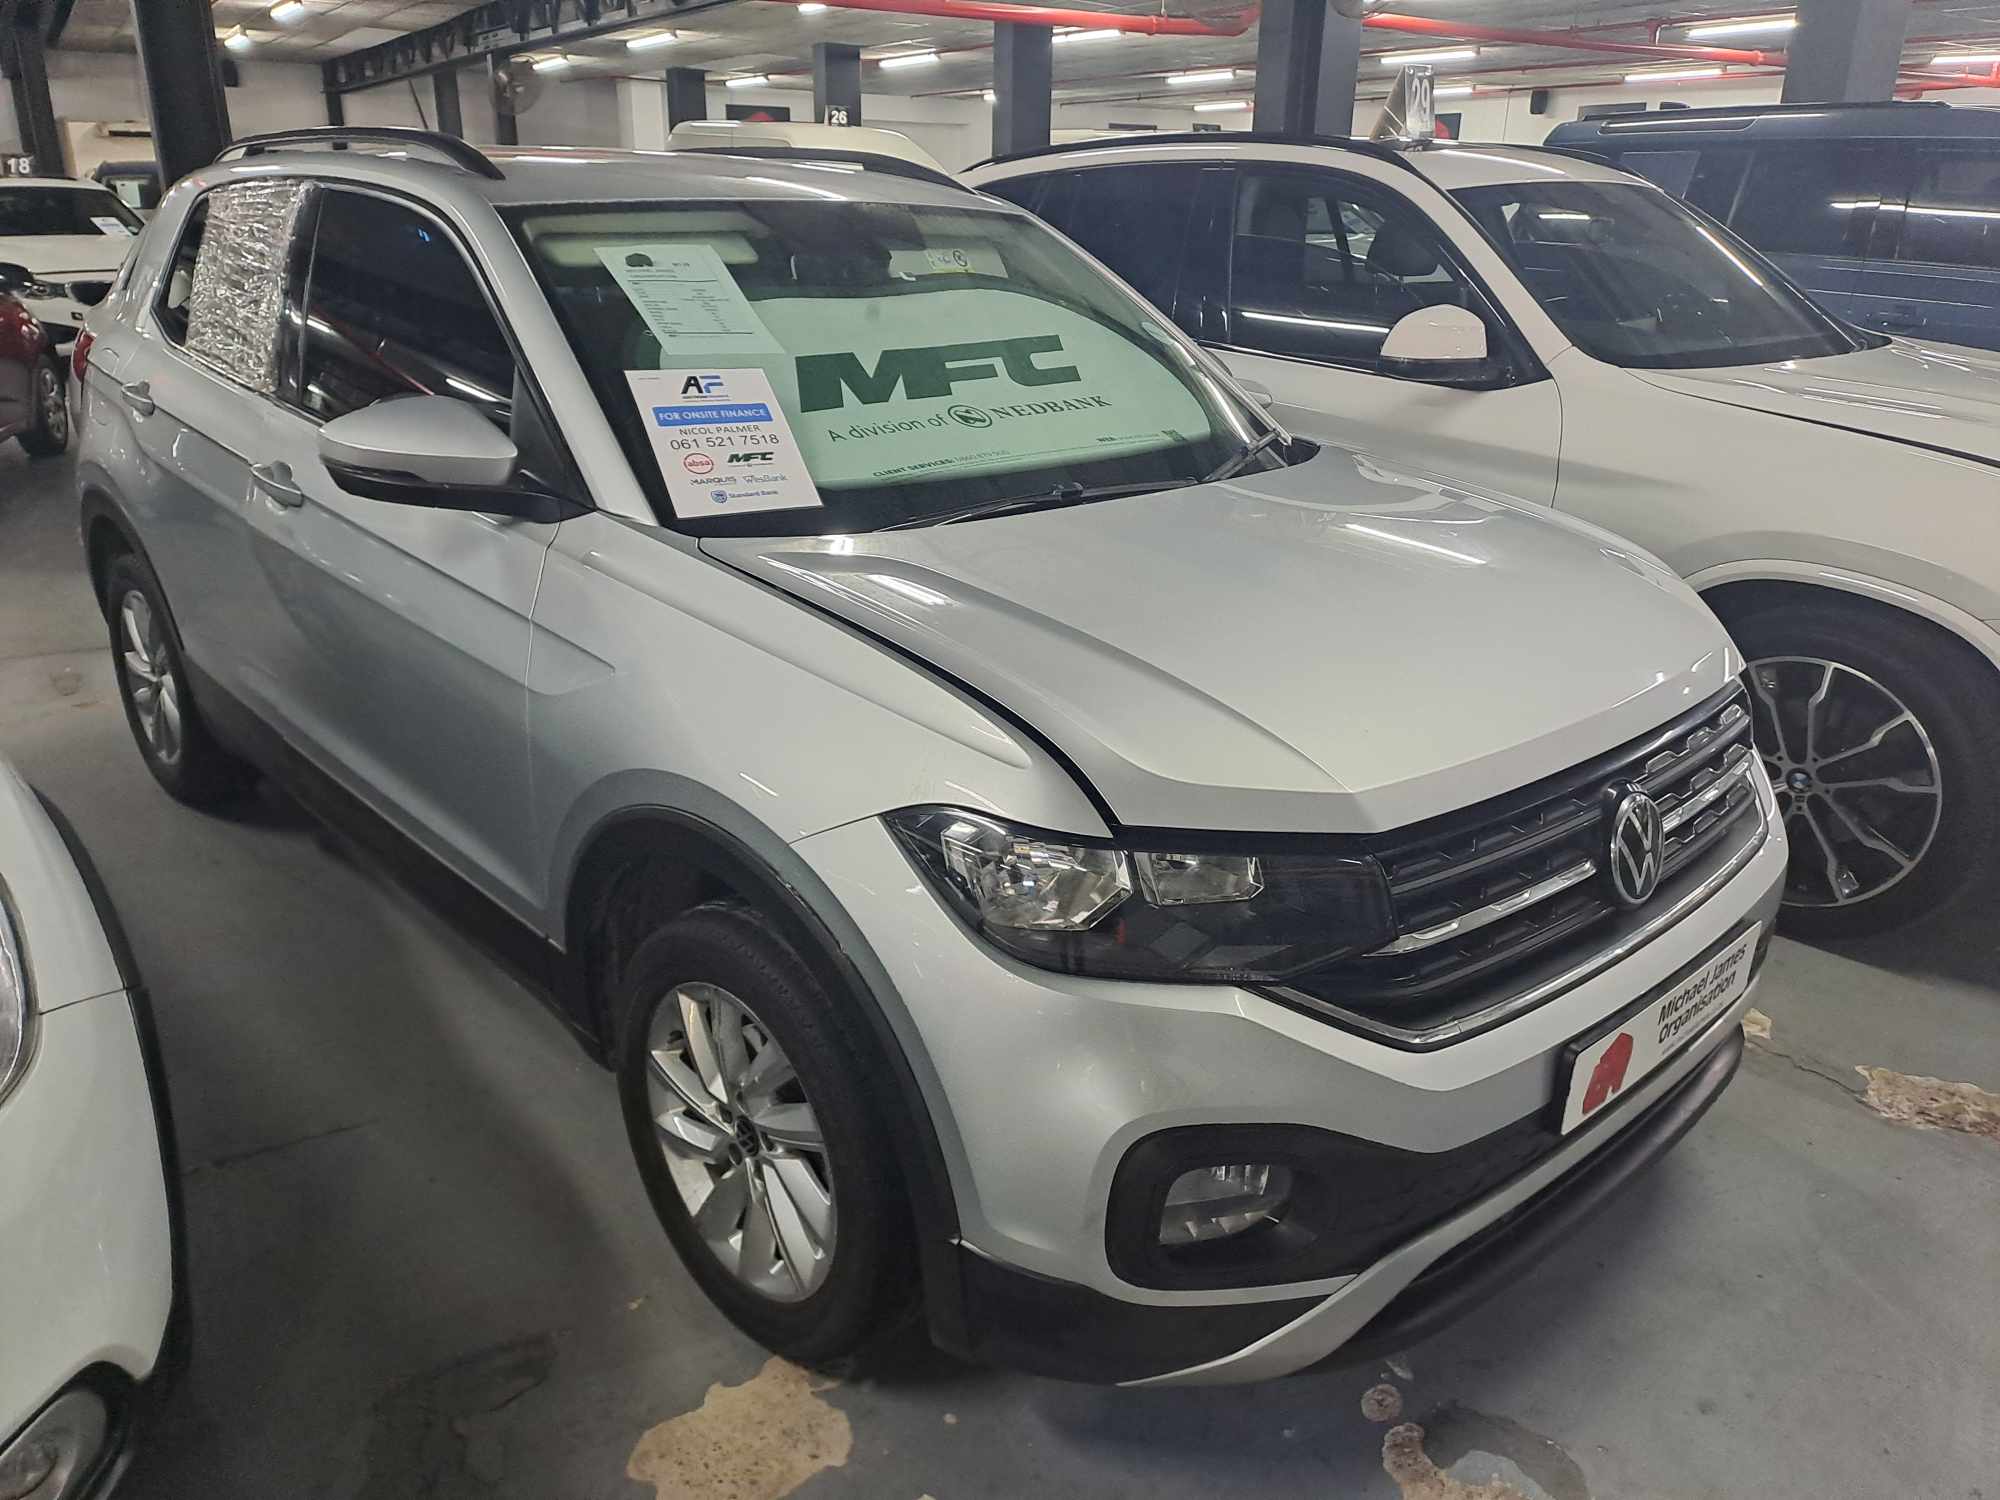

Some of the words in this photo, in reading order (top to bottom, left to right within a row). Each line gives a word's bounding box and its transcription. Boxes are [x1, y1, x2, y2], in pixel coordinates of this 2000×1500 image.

[831, 110, 848, 124] 26
[7, 157, 31, 175] 18
[794, 334, 1082, 413] MFC
[659, 411, 681, 421] FOR
[682, 411, 719, 420] ONSITE
[721, 409, 767, 419] FINANCE
[826, 429, 848, 443] A
[847, 416, 923, 440] division
[926, 412, 948, 428] of
[990, 394, 1113, 420] NEDBANK
[679, 426, 715, 436] NICOL
[716, 424, 761, 435] PALMER
[670, 438, 701, 451] 061
[705, 436, 735, 448] 521
[739, 434, 779, 446] 7518
[687, 458, 711, 468] absa
[727, 451, 775, 463] MFC
[1656, 970, 1710, 1026] Michael
[1709, 947, 1747, 985] James
